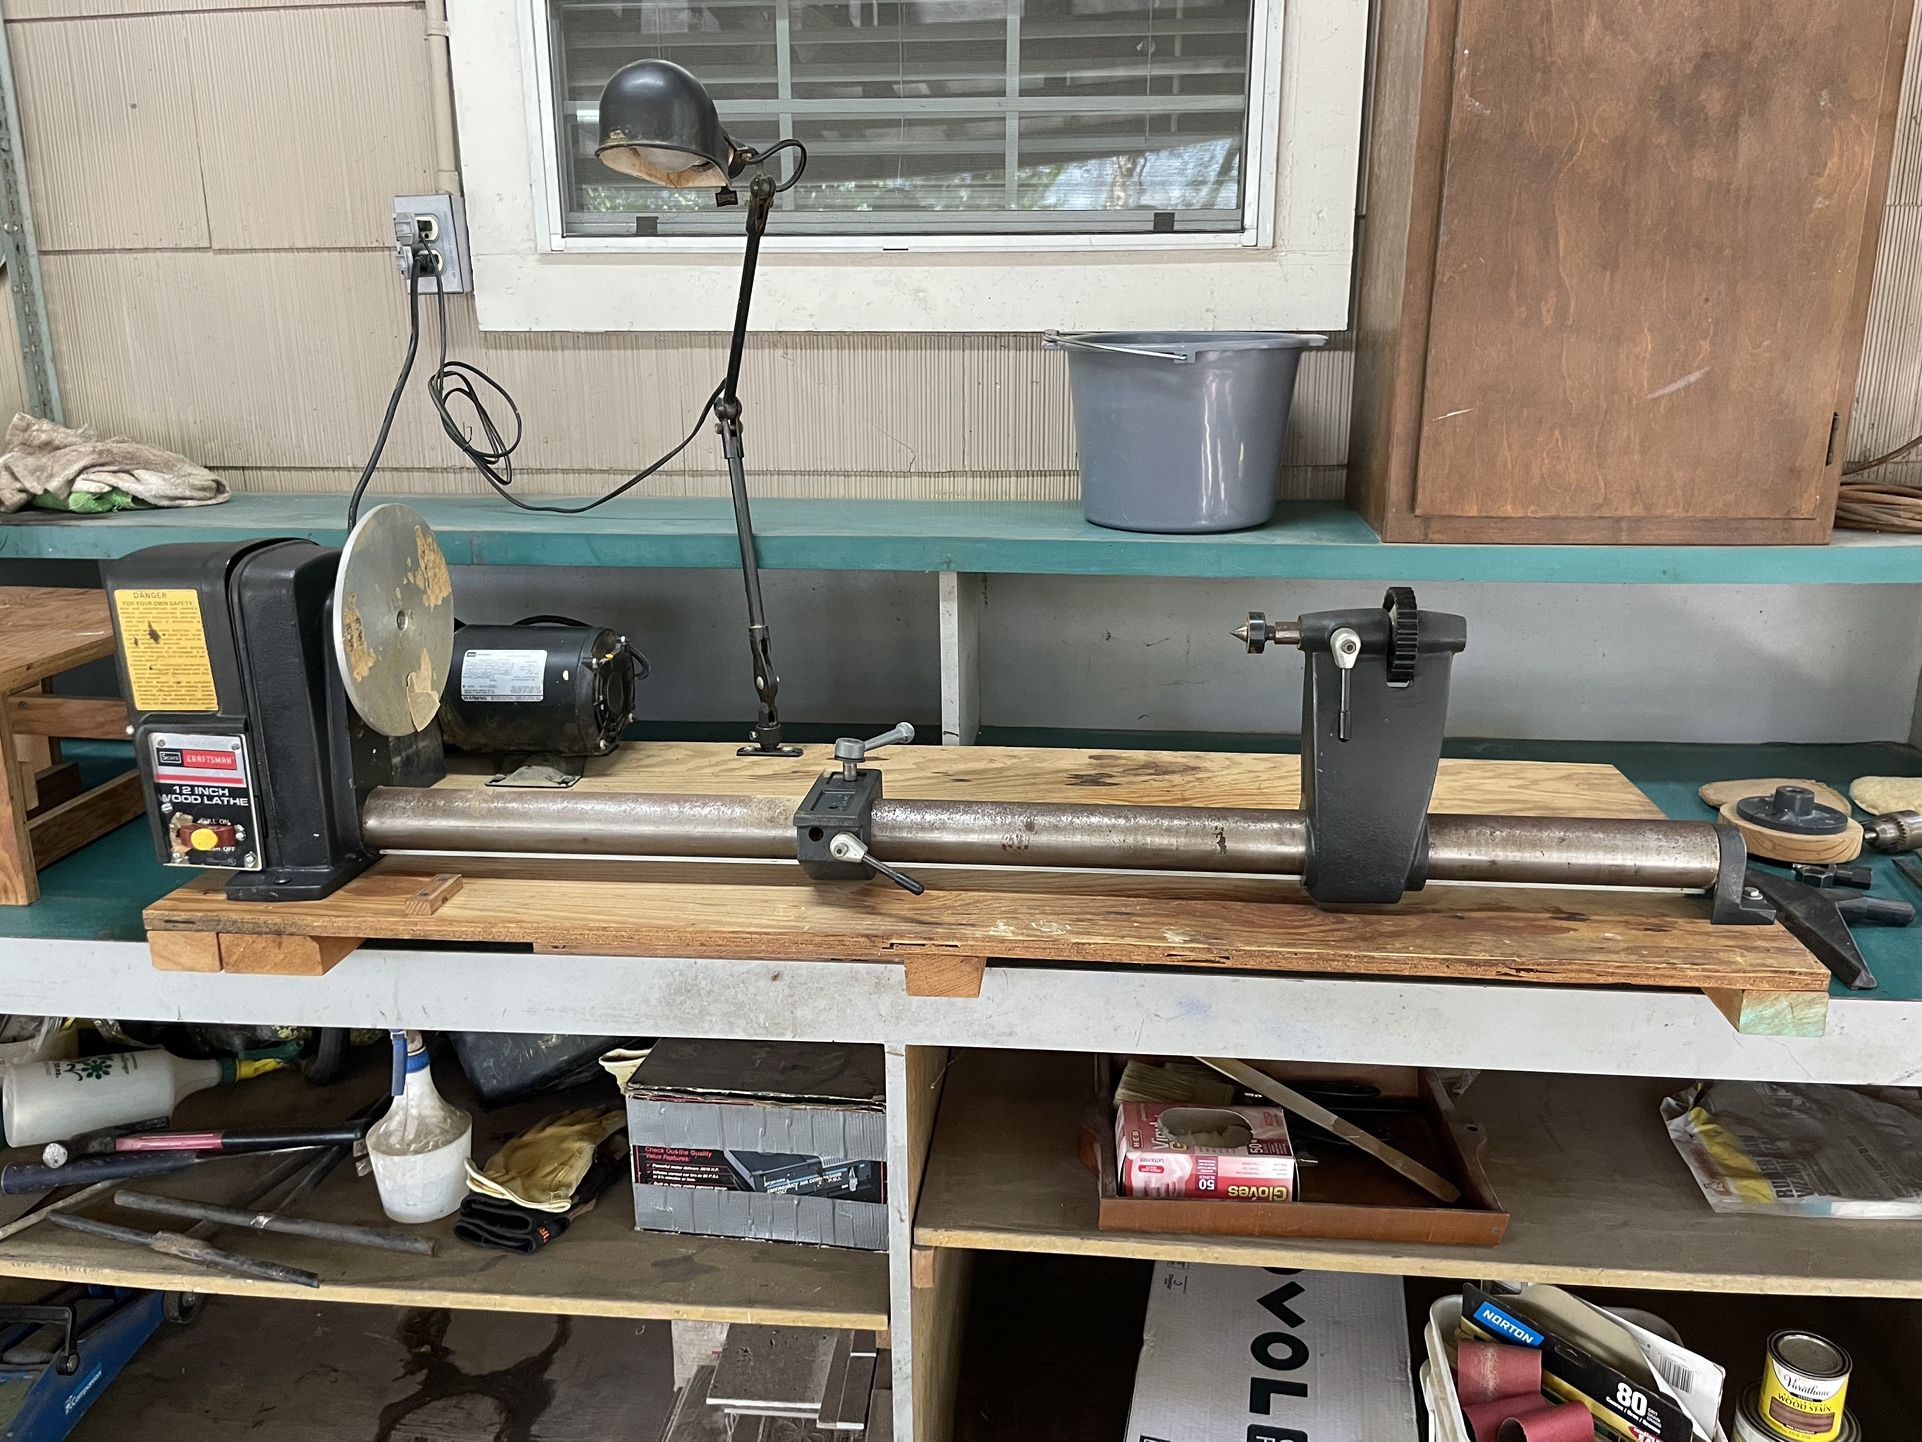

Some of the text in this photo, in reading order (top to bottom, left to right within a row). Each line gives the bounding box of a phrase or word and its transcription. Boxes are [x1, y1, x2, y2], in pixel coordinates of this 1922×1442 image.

[162, 752, 233, 765] Sears CRAFTSMAN
[173, 785, 229, 797] 12 INCH
[160, 793, 250, 807] WOOD LATHE
[689, 1149, 713, 1158] Quality
[1249, 1141, 1264, 1154] 50
[1199, 1179, 1215, 1191] 50
[1228, 1185, 1288, 1201] Gloves
[1482, 1309, 1534, 1344] NORTON
[1249, 1267, 1310, 1415] VOL
[1783, 1374, 1830, 1398] Varathane
[1616, 1382, 1648, 1417] 80
[1778, 1393, 1807, 1410] WOOD
